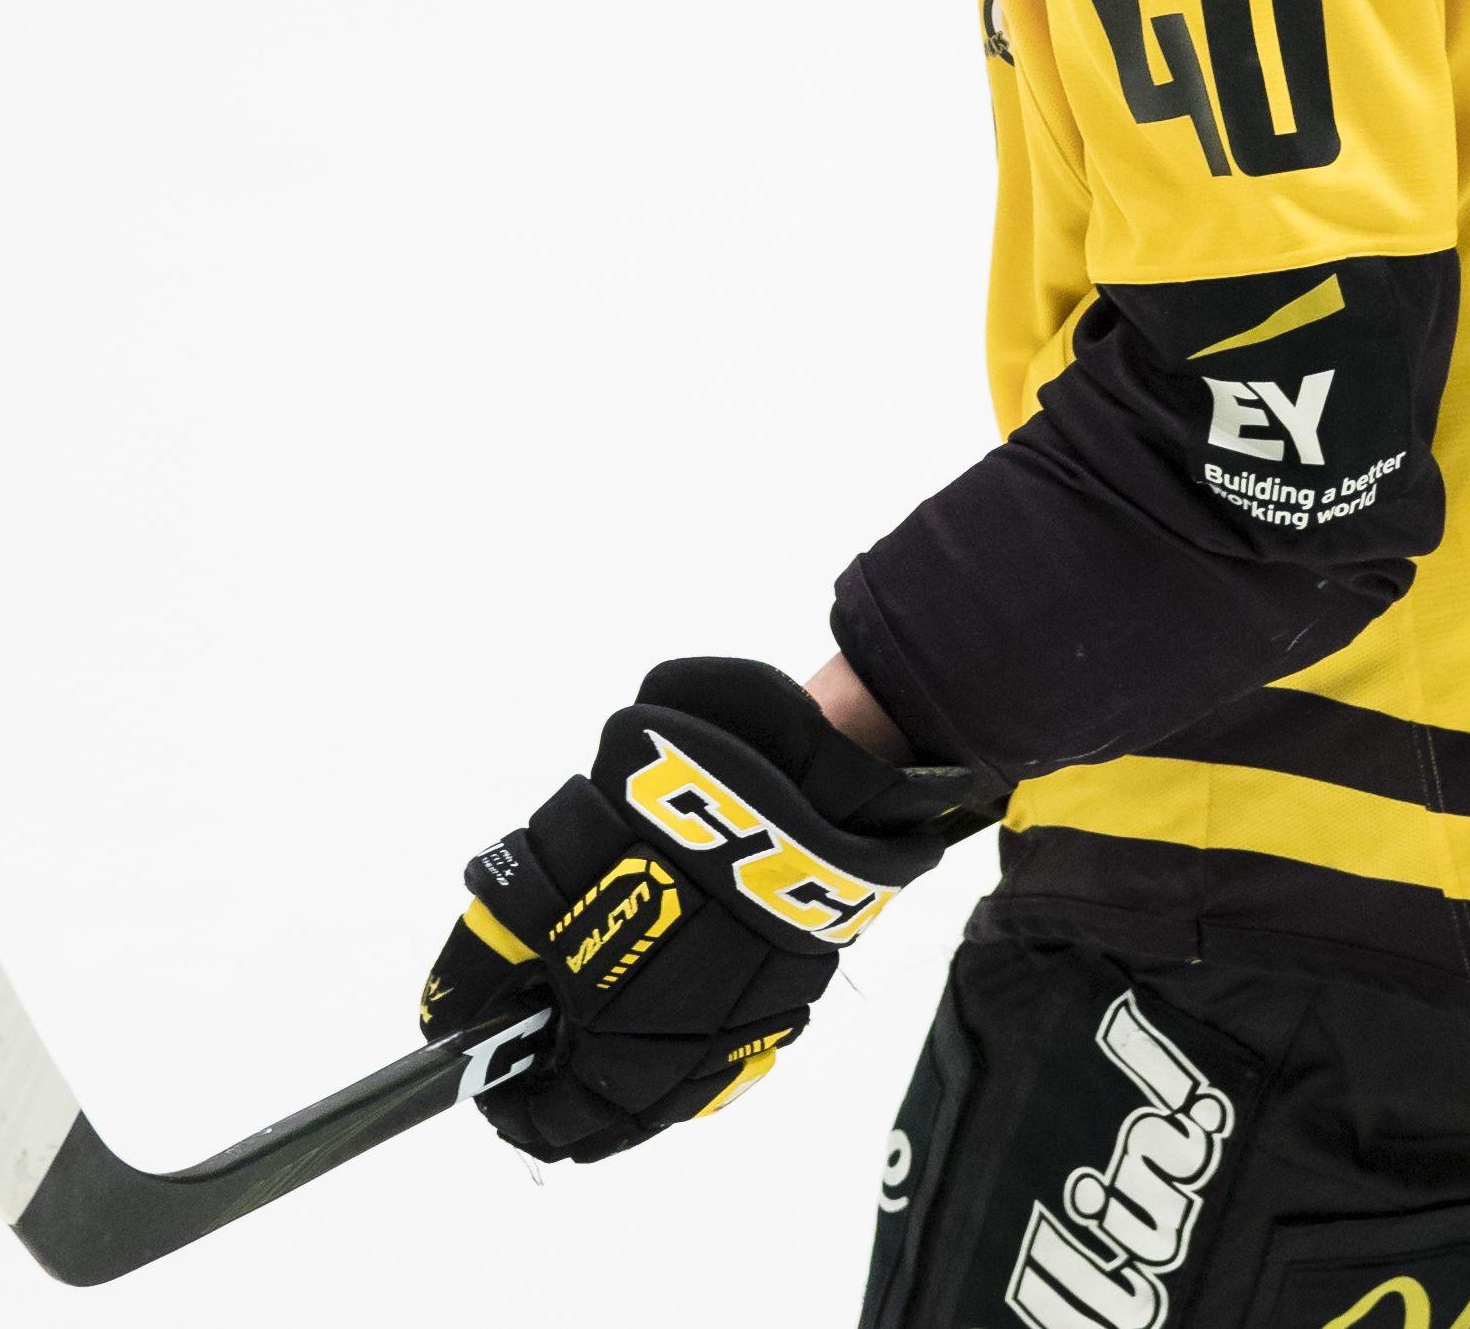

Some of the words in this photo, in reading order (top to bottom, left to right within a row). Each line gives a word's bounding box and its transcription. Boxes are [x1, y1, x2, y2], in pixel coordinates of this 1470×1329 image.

[1201, 369, 1336, 466] EY
[1204, 463, 1316, 511] Building
[1321, 487, 1336, 505] a
[1340, 451, 1407, 497] better
[1317, 483, 1378, 525] world
[626, 727, 903, 944] CC
[566, 881, 651, 973] ULTRA
